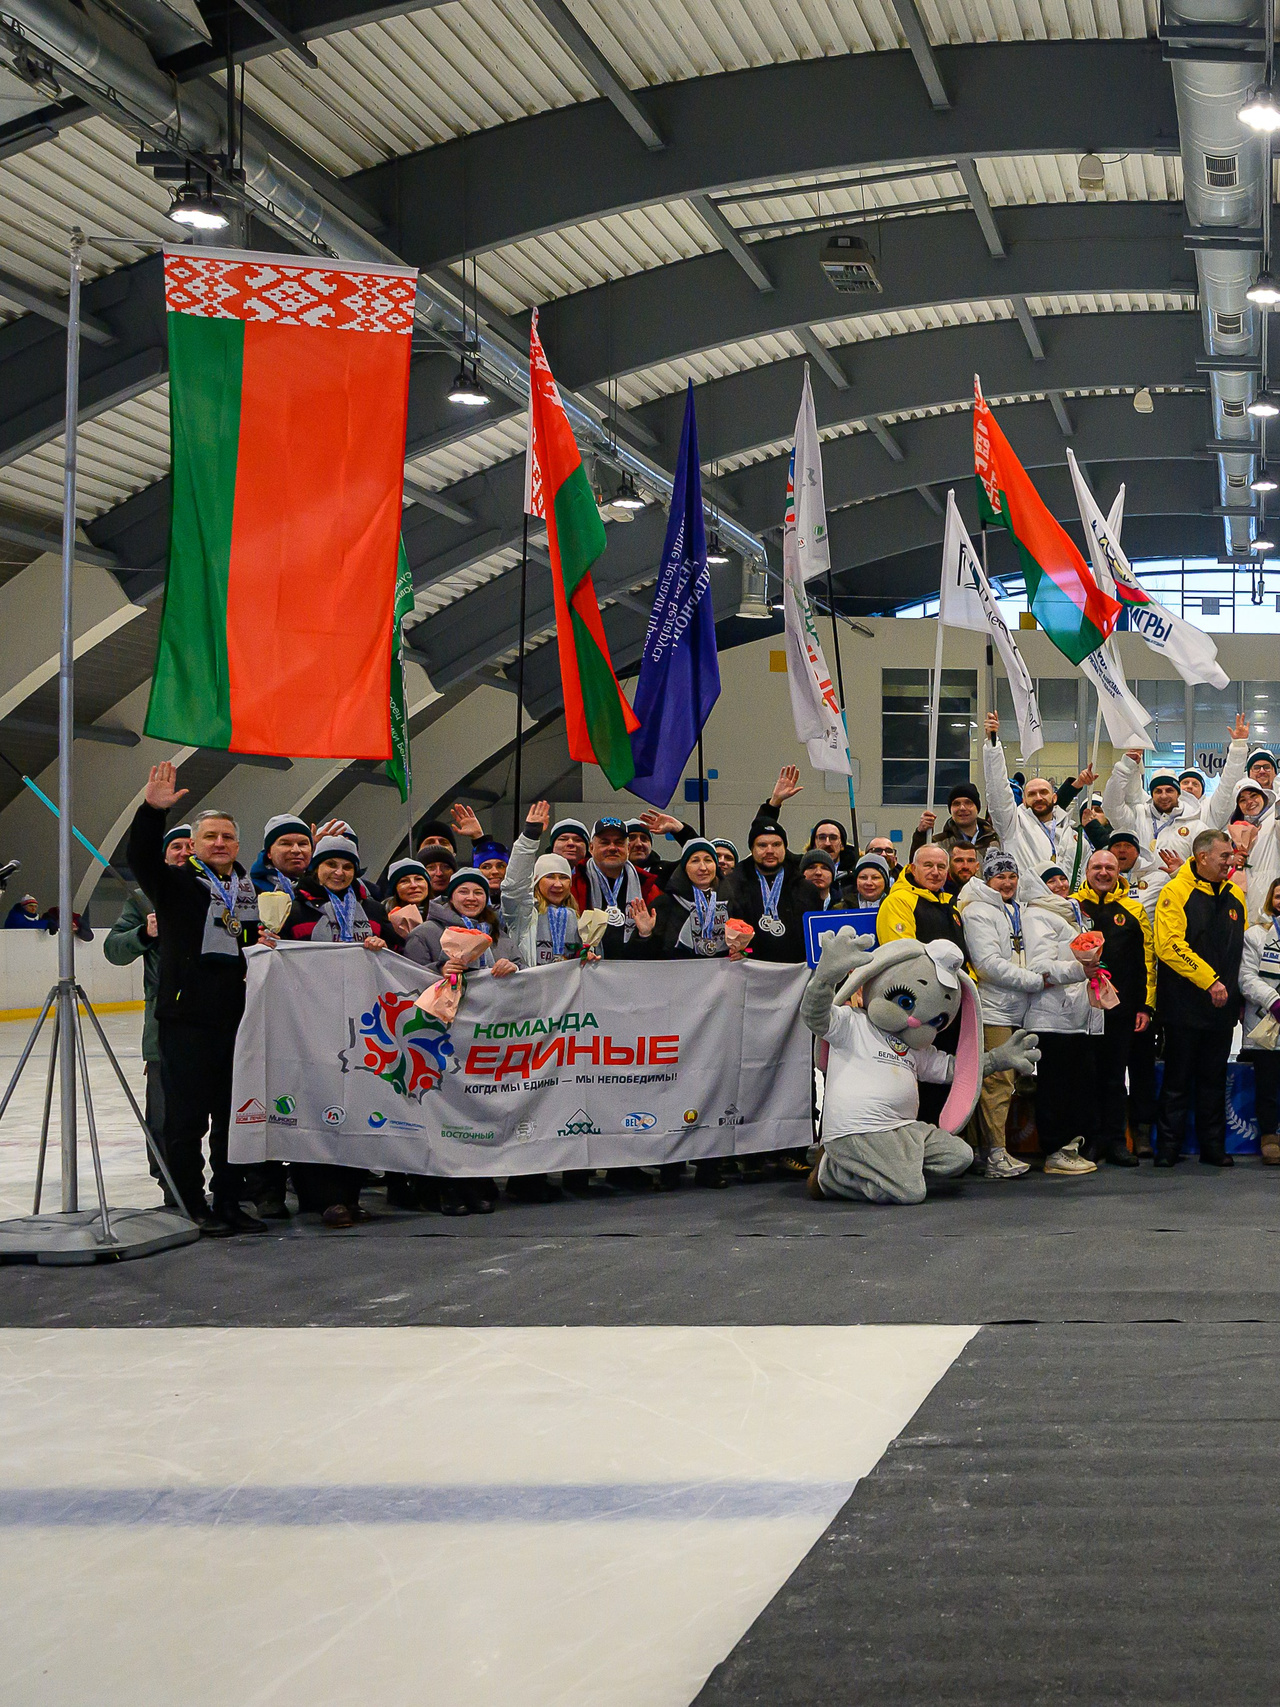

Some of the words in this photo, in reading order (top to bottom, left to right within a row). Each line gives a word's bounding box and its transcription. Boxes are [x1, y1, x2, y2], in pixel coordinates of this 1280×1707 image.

[1172, 943, 1199, 971] BELARUS
[473, 1012, 599, 1039] КОМАНДА
[464, 1035, 680, 1081] ЕДИНЫЕ
[464, 1083, 498, 1095] КОГДА
[500, 1081, 521, 1093] МЫ
[524, 1077, 559, 1091] ЕДИНЫ
[576, 1075, 595, 1084] МЫ
[598, 1073, 678, 1084] НЕПОБЕДИМЫ!
[441, 1130, 495, 1140] ВОСТОЧНЫЙ
